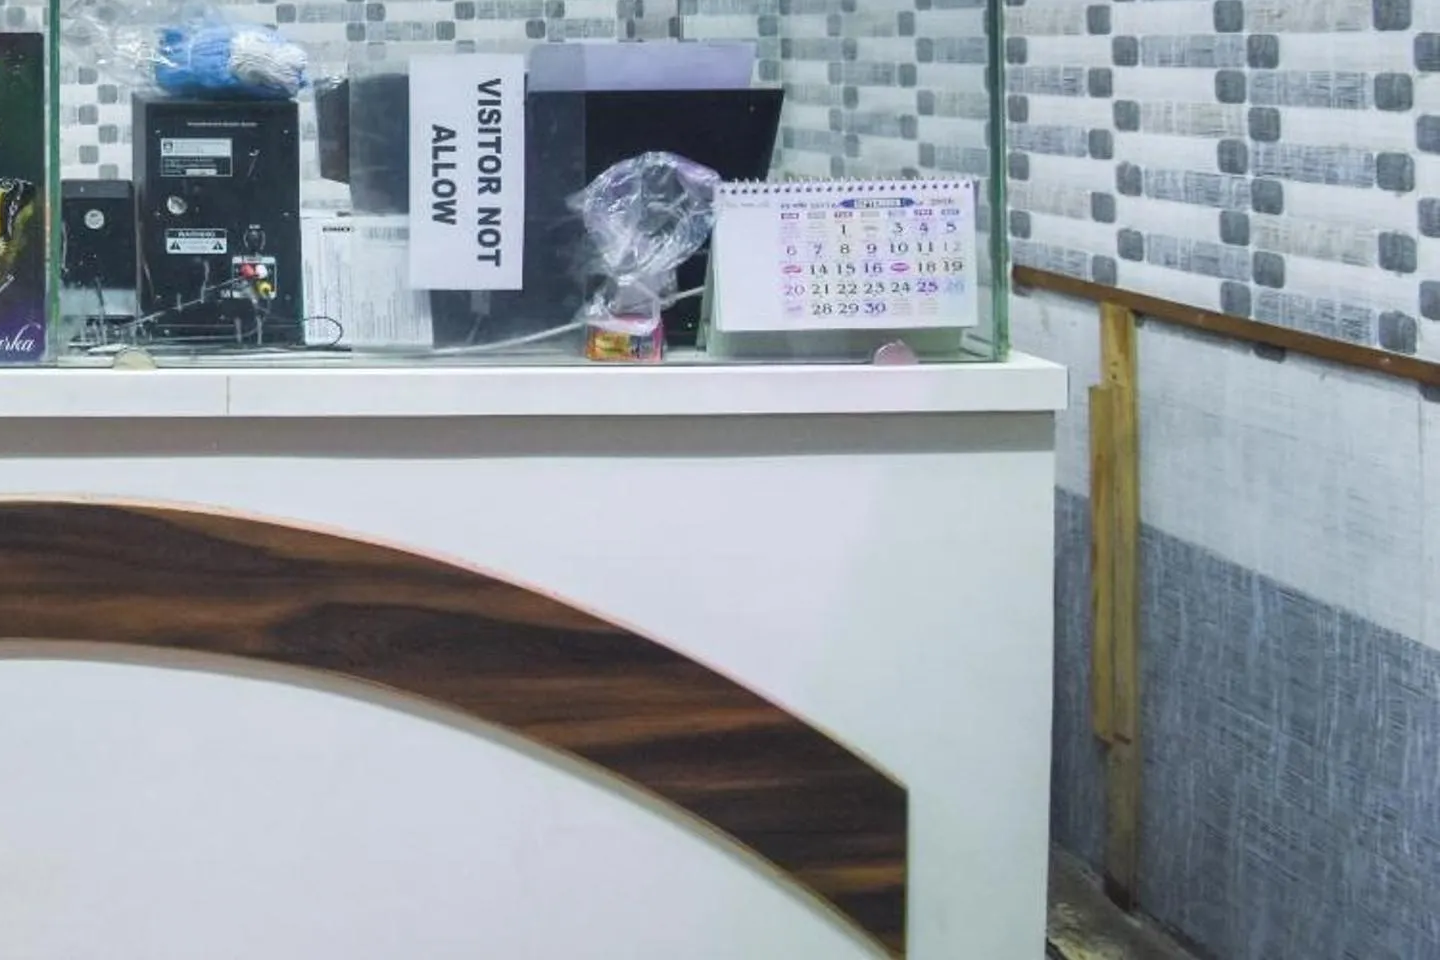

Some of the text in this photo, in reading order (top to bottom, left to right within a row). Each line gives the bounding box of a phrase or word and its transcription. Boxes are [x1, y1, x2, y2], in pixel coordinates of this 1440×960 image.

[431, 123, 457, 226] ALLOW
[477, 77, 502, 268] VISITOR NOT
[786, 245, 798, 257] 6
[840, 243, 851, 255] 8
[867, 243, 878, 255] 9
[890, 242, 909, 255] 10
[917, 241, 934, 253] 11
[809, 263, 828, 276] 14
[836, 263, 856, 275] 15
[864, 262, 883, 274] 16
[918, 261, 937, 273] 18
[943, 260, 964, 272] 19
[784, 284, 806, 297] 20
[811, 283, 829, 295] 21
[837, 283, 858, 295] 22
[863, 282, 885, 295] 23
[891, 281, 911, 293] 24
[916, 280, 939, 293] 25
[812, 302, 833, 316] 28
[837, 302, 860, 315] 29
[863, 301, 887, 314] 30
